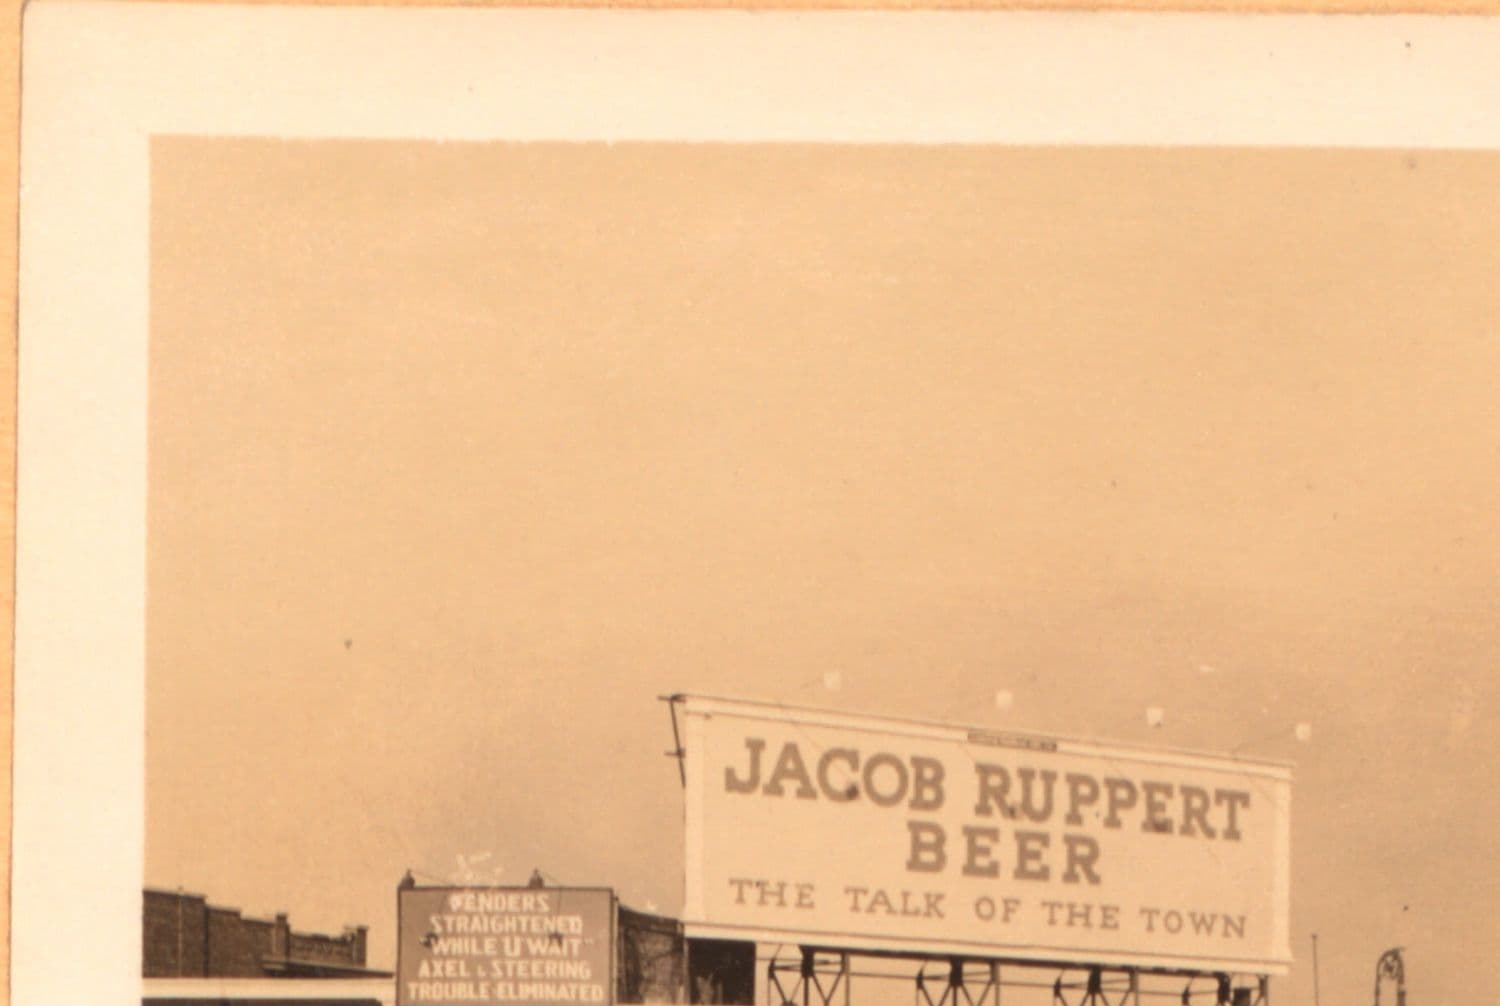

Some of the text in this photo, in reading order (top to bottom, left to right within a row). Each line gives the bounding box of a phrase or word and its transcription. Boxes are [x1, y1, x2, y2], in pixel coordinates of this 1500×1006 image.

[725, 737, 1250, 841] JACOB RUPPERT
[907, 820, 1101, 885] BEER
[449, 893, 549, 912] FENDERS
[728, 877, 1247, 938] THE TALK OF THE TOWN
[429, 915, 583, 935] STRAIGHTENED
[503, 937, 521, 956] U
[418, 960, 470, 978] AXEL
[491, 960, 592, 979] STEERING
[408, 981, 604, 1002] TROUBLE ELIMINATED
